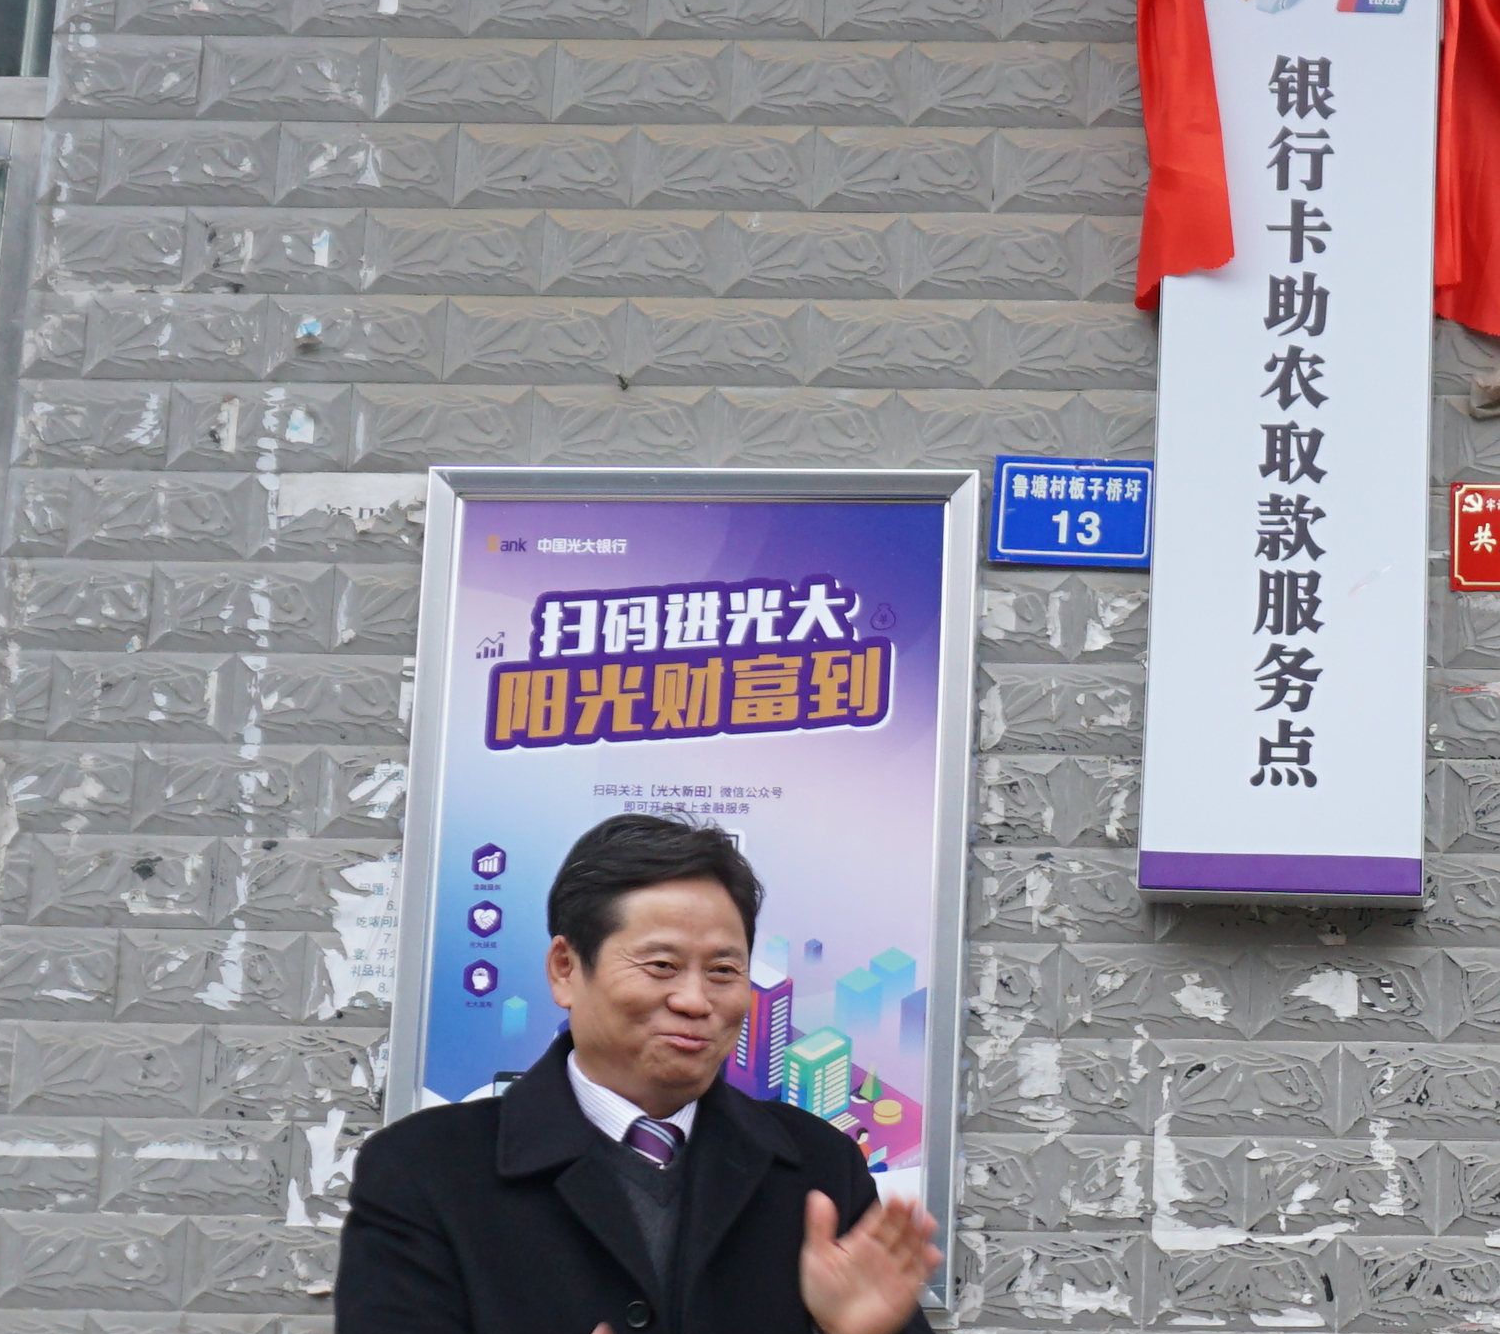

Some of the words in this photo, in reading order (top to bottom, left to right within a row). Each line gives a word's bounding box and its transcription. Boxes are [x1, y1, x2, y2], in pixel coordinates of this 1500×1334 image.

[1249, 54, 1337, 788] 银行卡助农取款服务点
[537, 537, 627, 554] 中国光大银行
[1051, 510, 1101, 546] 13
[539, 583, 846, 658] 扫码进光大
[495, 647, 881, 741] 阳光财富到
